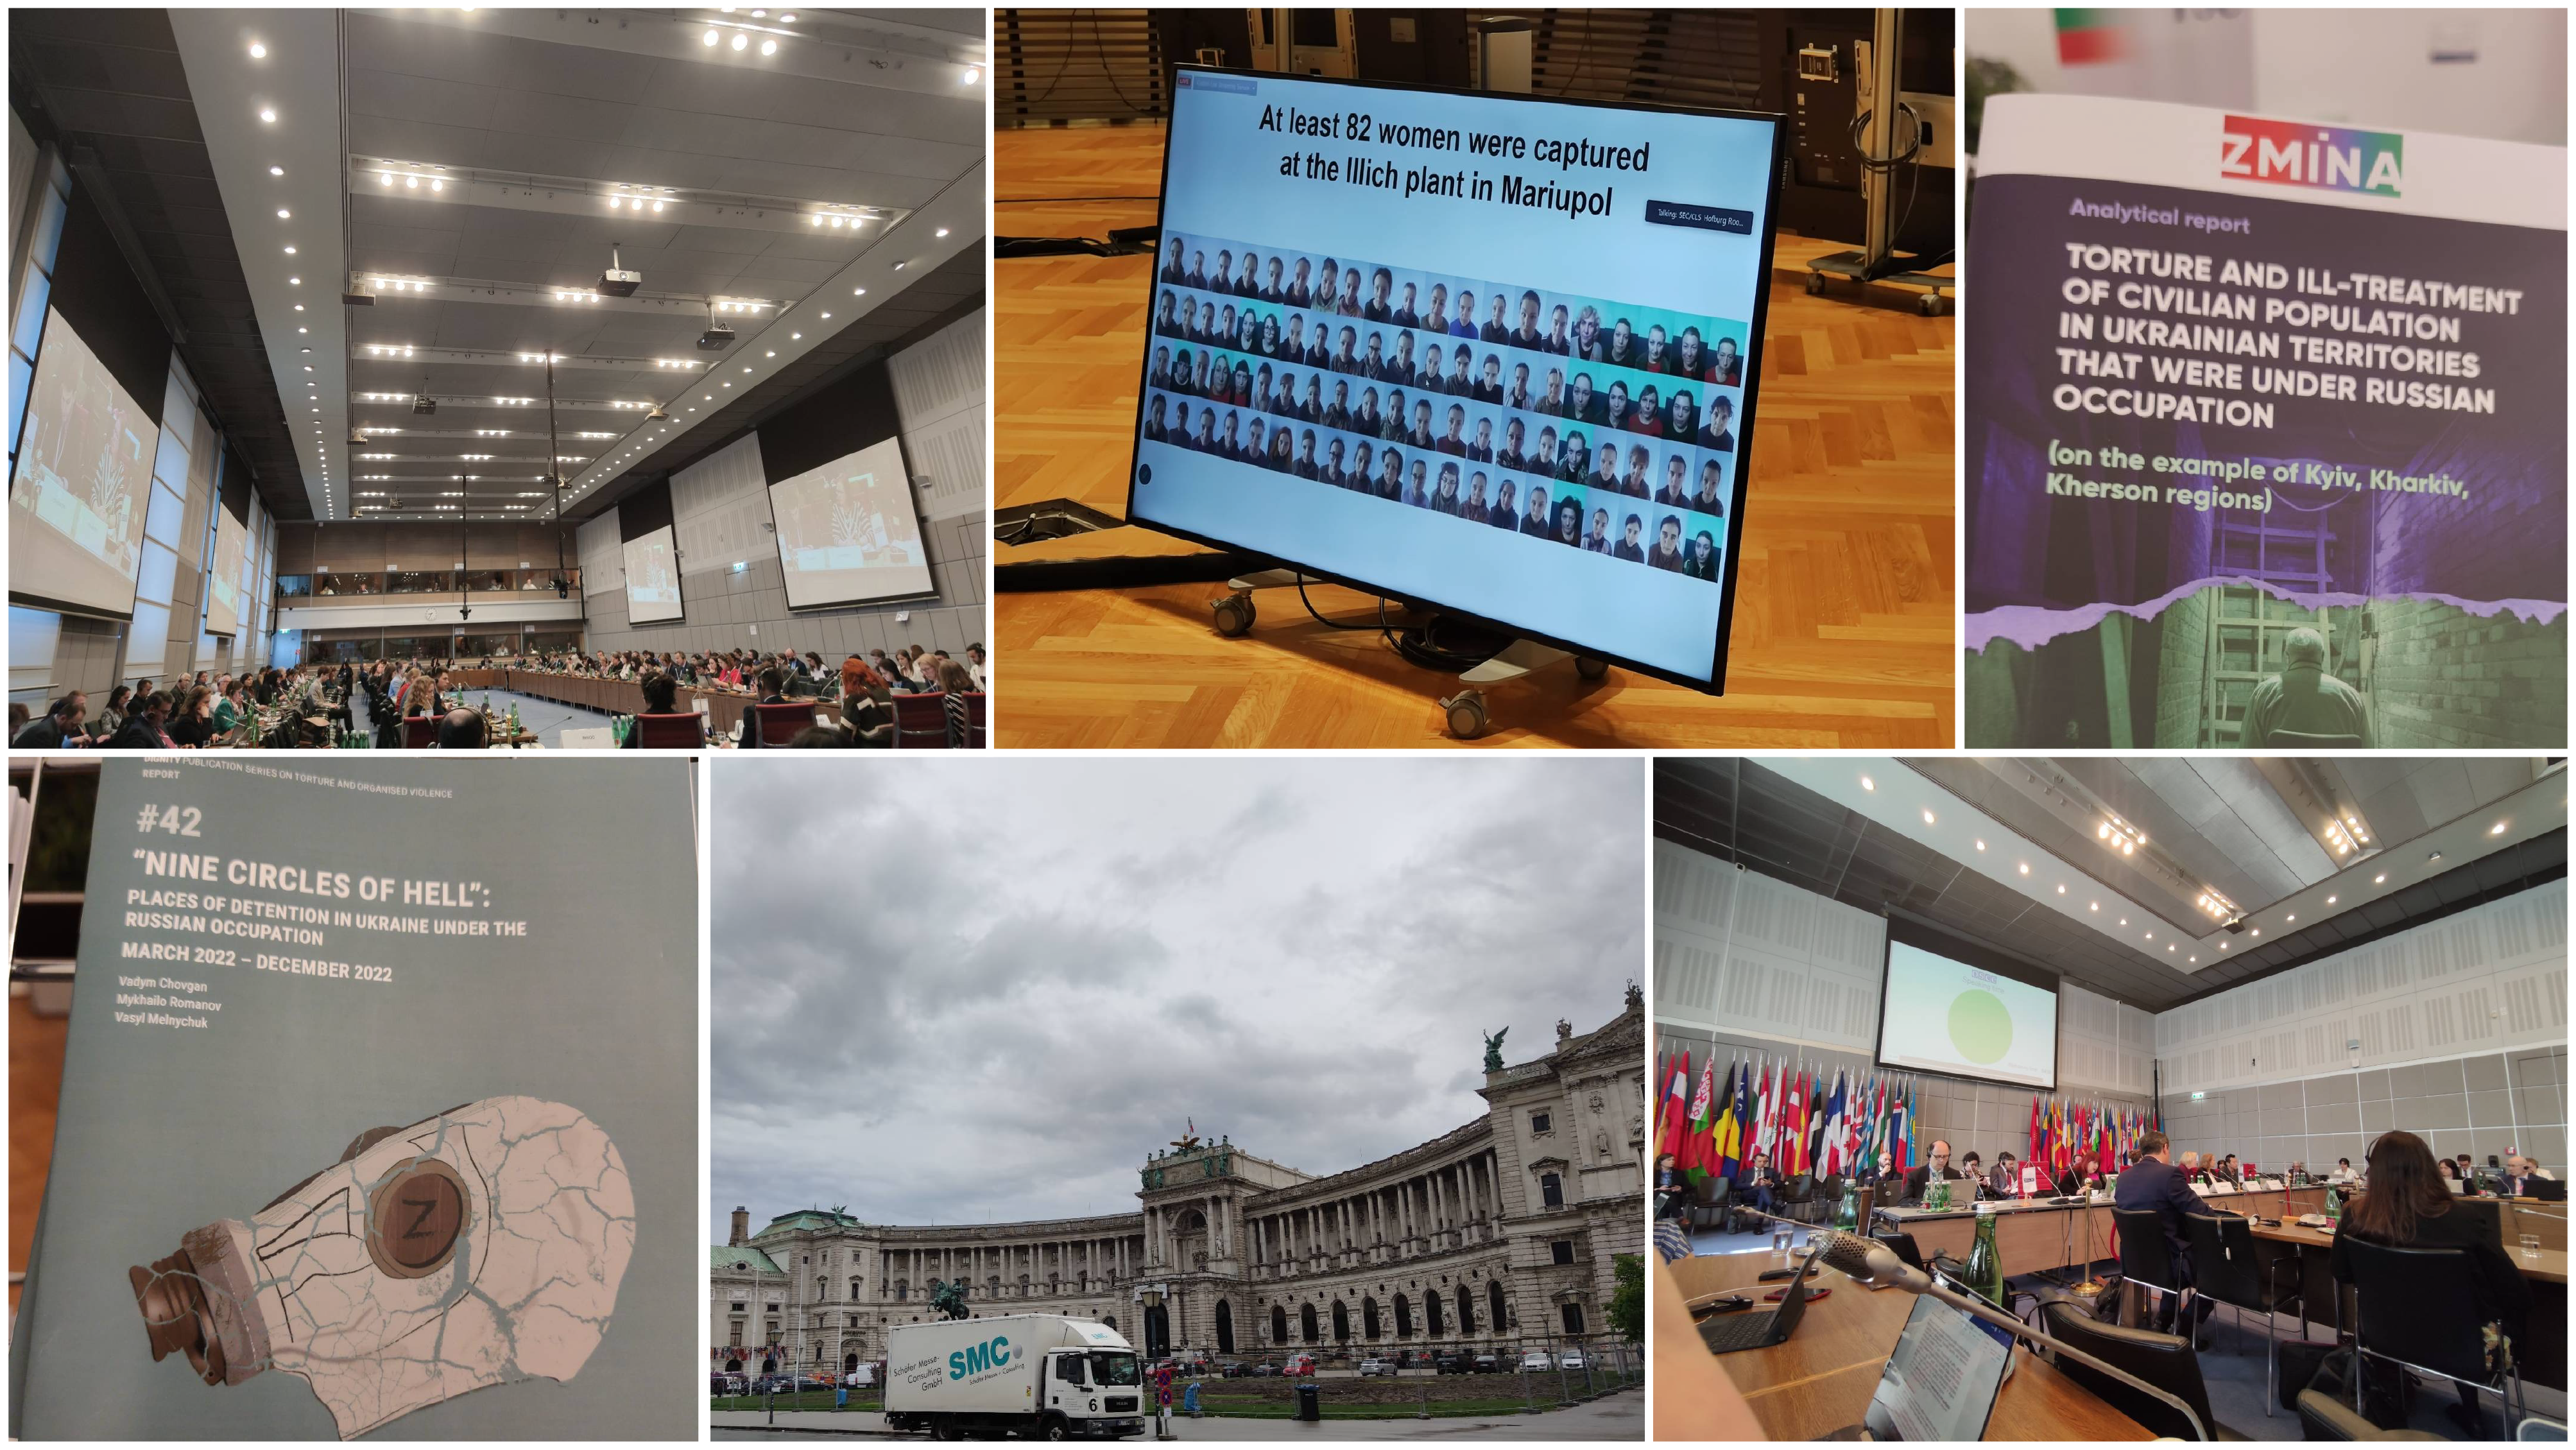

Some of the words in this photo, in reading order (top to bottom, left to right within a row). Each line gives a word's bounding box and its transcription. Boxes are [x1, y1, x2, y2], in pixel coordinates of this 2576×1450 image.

[1259, 104, 1283, 132] At
[1290, 107, 1340, 138] least
[1346, 113, 1371, 141] 82
[1379, 123, 1459, 151] women
[1470, 133, 1525, 159] were
[1534, 138, 1649, 171] captured
[1280, 151, 1300, 177] at
[1307, 153, 1339, 181] the
[1347, 157, 1398, 189] Illich
[1405, 166, 1464, 198] plant
[1472, 171, 1492, 201] in
[1502, 175, 1612, 220] Mariupol
[1658, 209, 1677, 220] Talking:
[1679, 212, 1701, 221] SEC/CLS
[1704, 215, 1726, 226] Hofburg
[2070, 198, 2178, 225] Analytical
[2185, 209, 2250, 234] report
[2066, 243, 2211, 281] TORTURE
[2220, 260, 2288, 289] AND
[2297, 268, 2522, 315] ILL-TREATMENT
[2063, 278, 2109, 305] OF
[2118, 282, 2255, 321] CIVILIAN
[2266, 298, 2459, 343] POPULATION
[2060, 313, 2093, 340] IN
[2104, 316, 2280, 358] UKRAINIAN
[2289, 336, 2480, 377] TERRITORIES
[2056, 348, 2142, 379] THAT
[2151, 356, 2242, 390] WERE
[2253, 367, 2357, 401] UNDER
[2367, 378, 2494, 413] RUSSIAN
[2054, 384, 2273, 428] OCCUPATION
[2049, 439, 2092, 466] (on
[2100, 447, 2145, 470] the
[2152, 456, 2265, 483] example
[2273, 463, 2299, 483] of
[2305, 463, 2362, 491] Kyiv,
[2370, 469, 2468, 499] Kharkiv,
[2047, 472, 2158, 502] Kherson
[2167, 485, 2272, 514] regions)
[142, 769, 180, 779] REPORT
[182, 757, 243, 771] PUBLICATION
[245, 765, 277, 777] SERIES
[279, 770, 292, 779] ON
[295, 772, 334, 787] TORTURE
[338, 780, 356, 789] AND
[357, 782, 408, 795] ORGANISED
[410, 788, 452, 798] VIOLENCE
[137, 804, 202, 837] #42
[133, 849, 219, 881] “NINE
[228, 860, 350, 898] CIRCLES
[359, 877, 395, 901] OF
[404, 881, 489, 907] HELL”:
[126, 911, 205, 932] RUSSIAN
[210, 919, 323, 945] OCCUPATION
[128, 890, 198, 908] PLACES
[203, 895, 226, 911] OF
[231, 899, 329, 924] DETENTION
[335, 911, 351, 927] IN
[356, 914, 429, 933] UKRAINE
[434, 920, 488, 935] UNDER
[492, 919, 527, 938] THE
[122, 942, 189, 961] MARCH
[194, 947, 236, 966] 2022
[257, 954, 349, 978] DECEMBER
[355, 965, 391, 982] 2022
[116, 993, 166, 1010] Mykhailo
[169, 996, 221, 1011] Romanov
[119, 975, 156, 992] Vadym
[159, 978, 207, 993] Chovgan
[115, 1011, 145, 1028] Vasyl
[148, 1013, 207, 1028] Melnychuk
[402, 1199, 436, 1239] Z
[907, 1367, 941, 1383] Consulting
[918, 1356, 940, 1369] Messe-
[949, 1336, 1010, 1380] SMC
[922, 1377, 942, 1391] GmbH
[1089, 1399, 1097, 1412] 6
